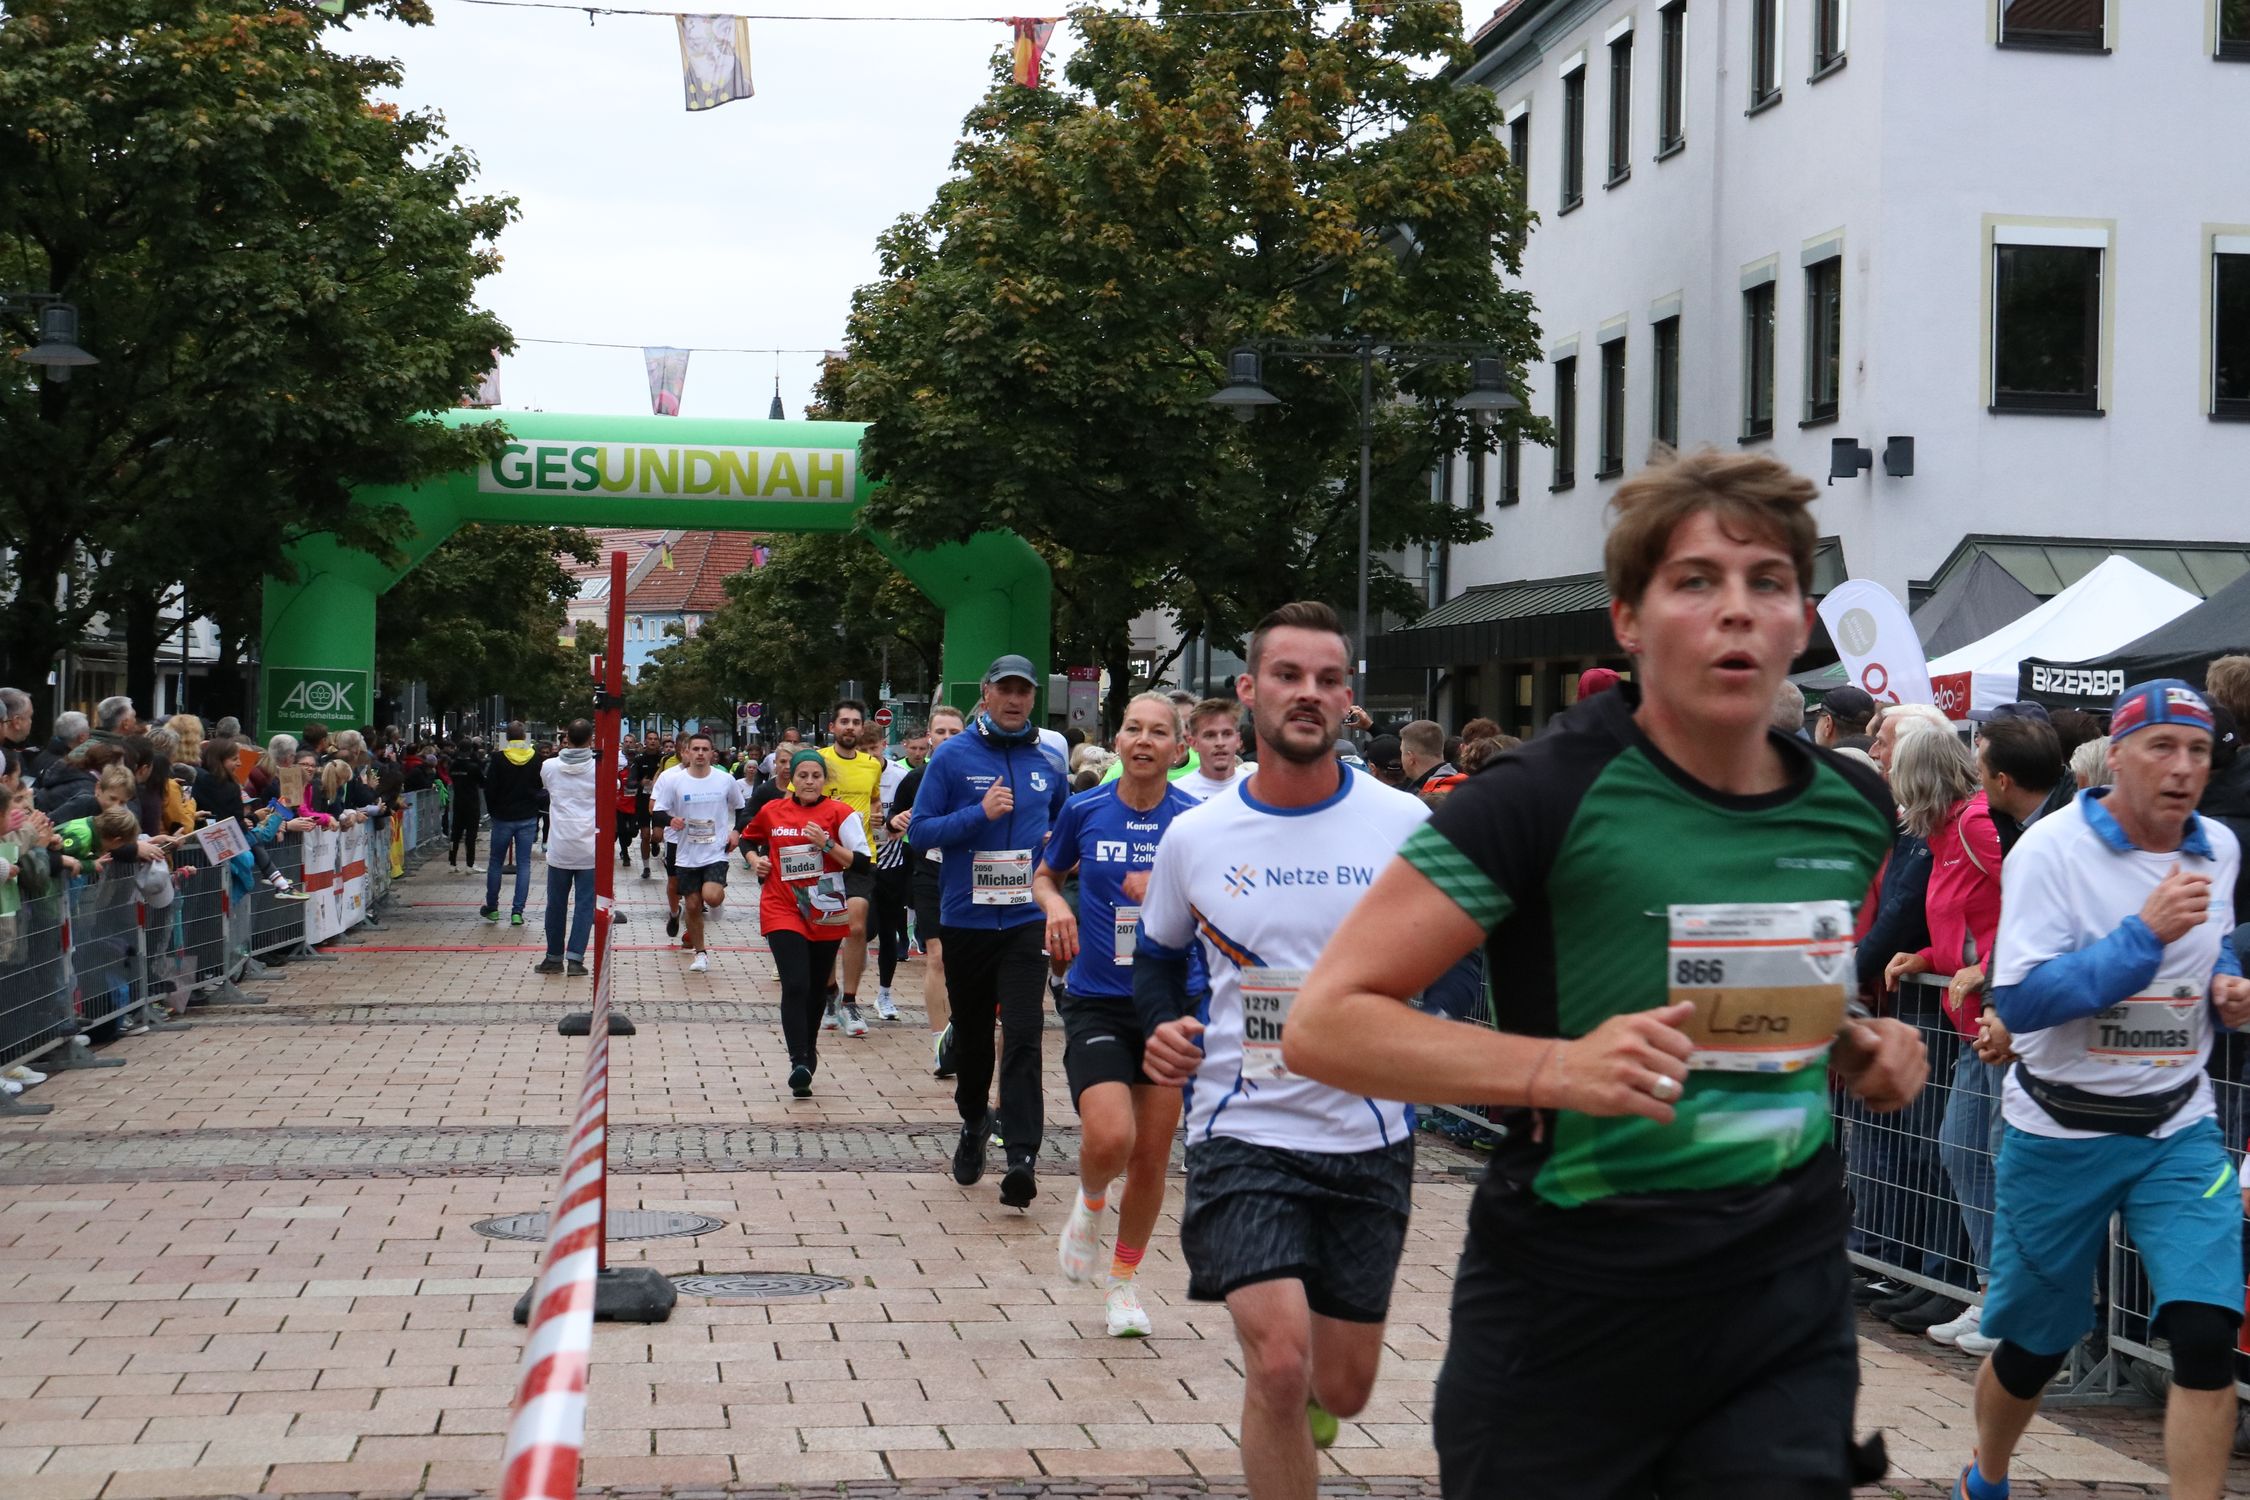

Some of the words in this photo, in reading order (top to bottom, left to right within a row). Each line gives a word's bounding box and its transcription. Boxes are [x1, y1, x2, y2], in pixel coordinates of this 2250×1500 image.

[492, 443, 844, 498] GESUNDNAH
[2032, 666, 2125, 696] BIZERBA
[280, 680, 354, 711] AOK
[771, 826, 799, 837] MÖBEL
[1126, 821, 1158, 832] Kempa
[786, 862, 816, 874] Nadda
[974, 864, 992, 872] 2050
[1266, 866, 1329, 887] Netze
[1337, 865, 1374, 886] BW
[977, 873, 1027, 886] Michael
[1010, 896, 1027, 904] 2050
[1117, 924, 1137, 934] 207
[1676, 959, 1723, 985] 866
[1244, 996, 1280, 1012] 1279
[1709, 992, 1790, 1036] Lena
[2099, 1024, 2190, 1049] Thomas
